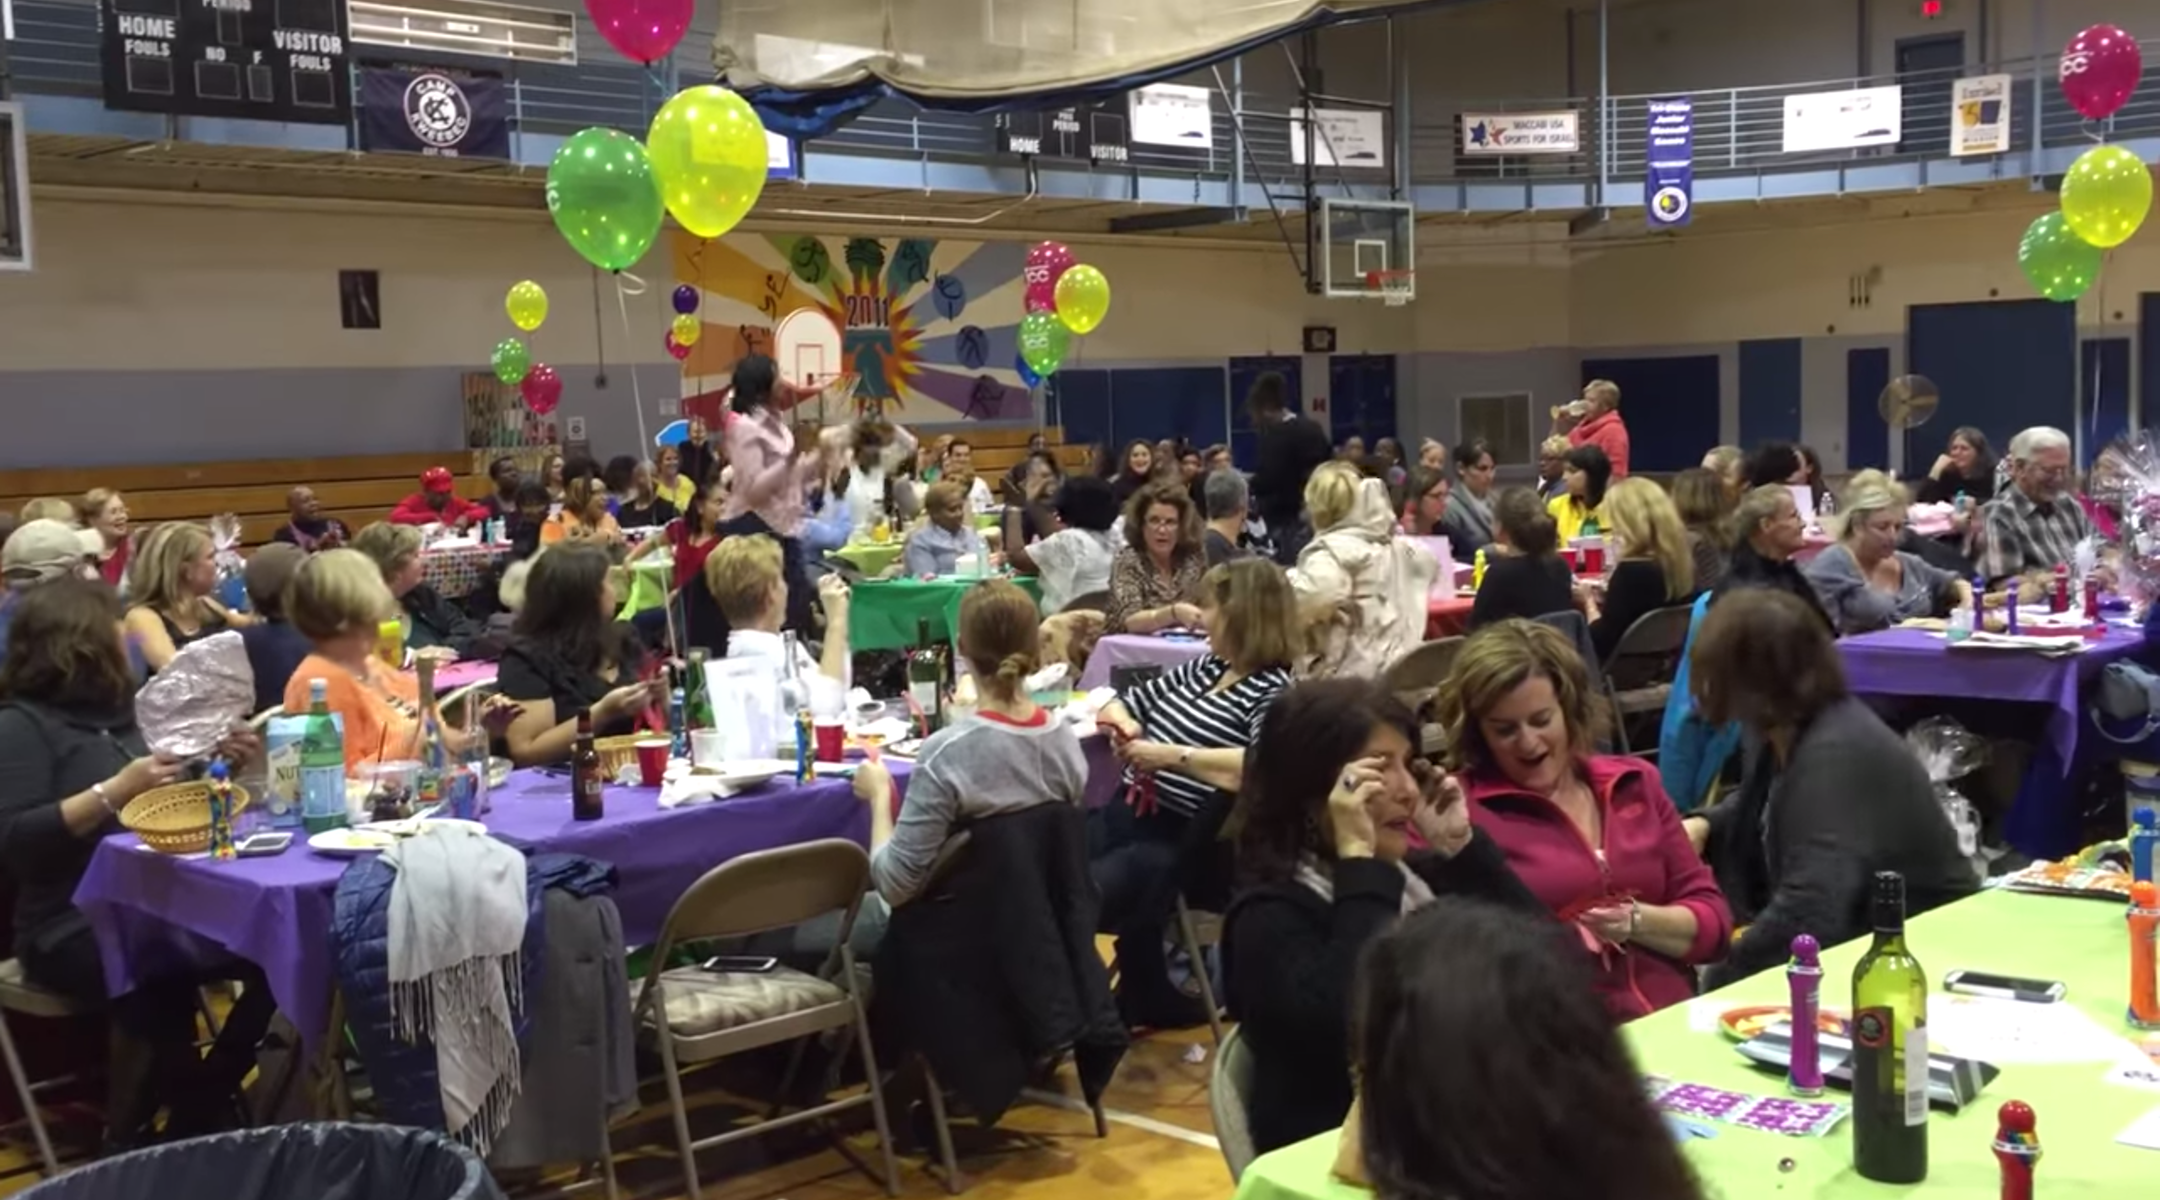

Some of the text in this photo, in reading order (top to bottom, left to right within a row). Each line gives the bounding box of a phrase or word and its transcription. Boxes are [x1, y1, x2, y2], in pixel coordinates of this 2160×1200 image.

[118, 15, 175, 38] HOME
[125, 39, 171, 56] FOULS
[273, 31, 343, 54] VISITOR
[290, 54, 331, 71] FOULS
[415, 79, 456, 97] CAMP
[1550, 119, 1565, 129] USA
[1009, 137, 1041, 153] HOME
[1503, 133, 1531, 145] SPORTS
[1532, 133, 1547, 144] FOR
[1090, 145, 1128, 161] VISITOR
[846, 294, 889, 327] 2011
